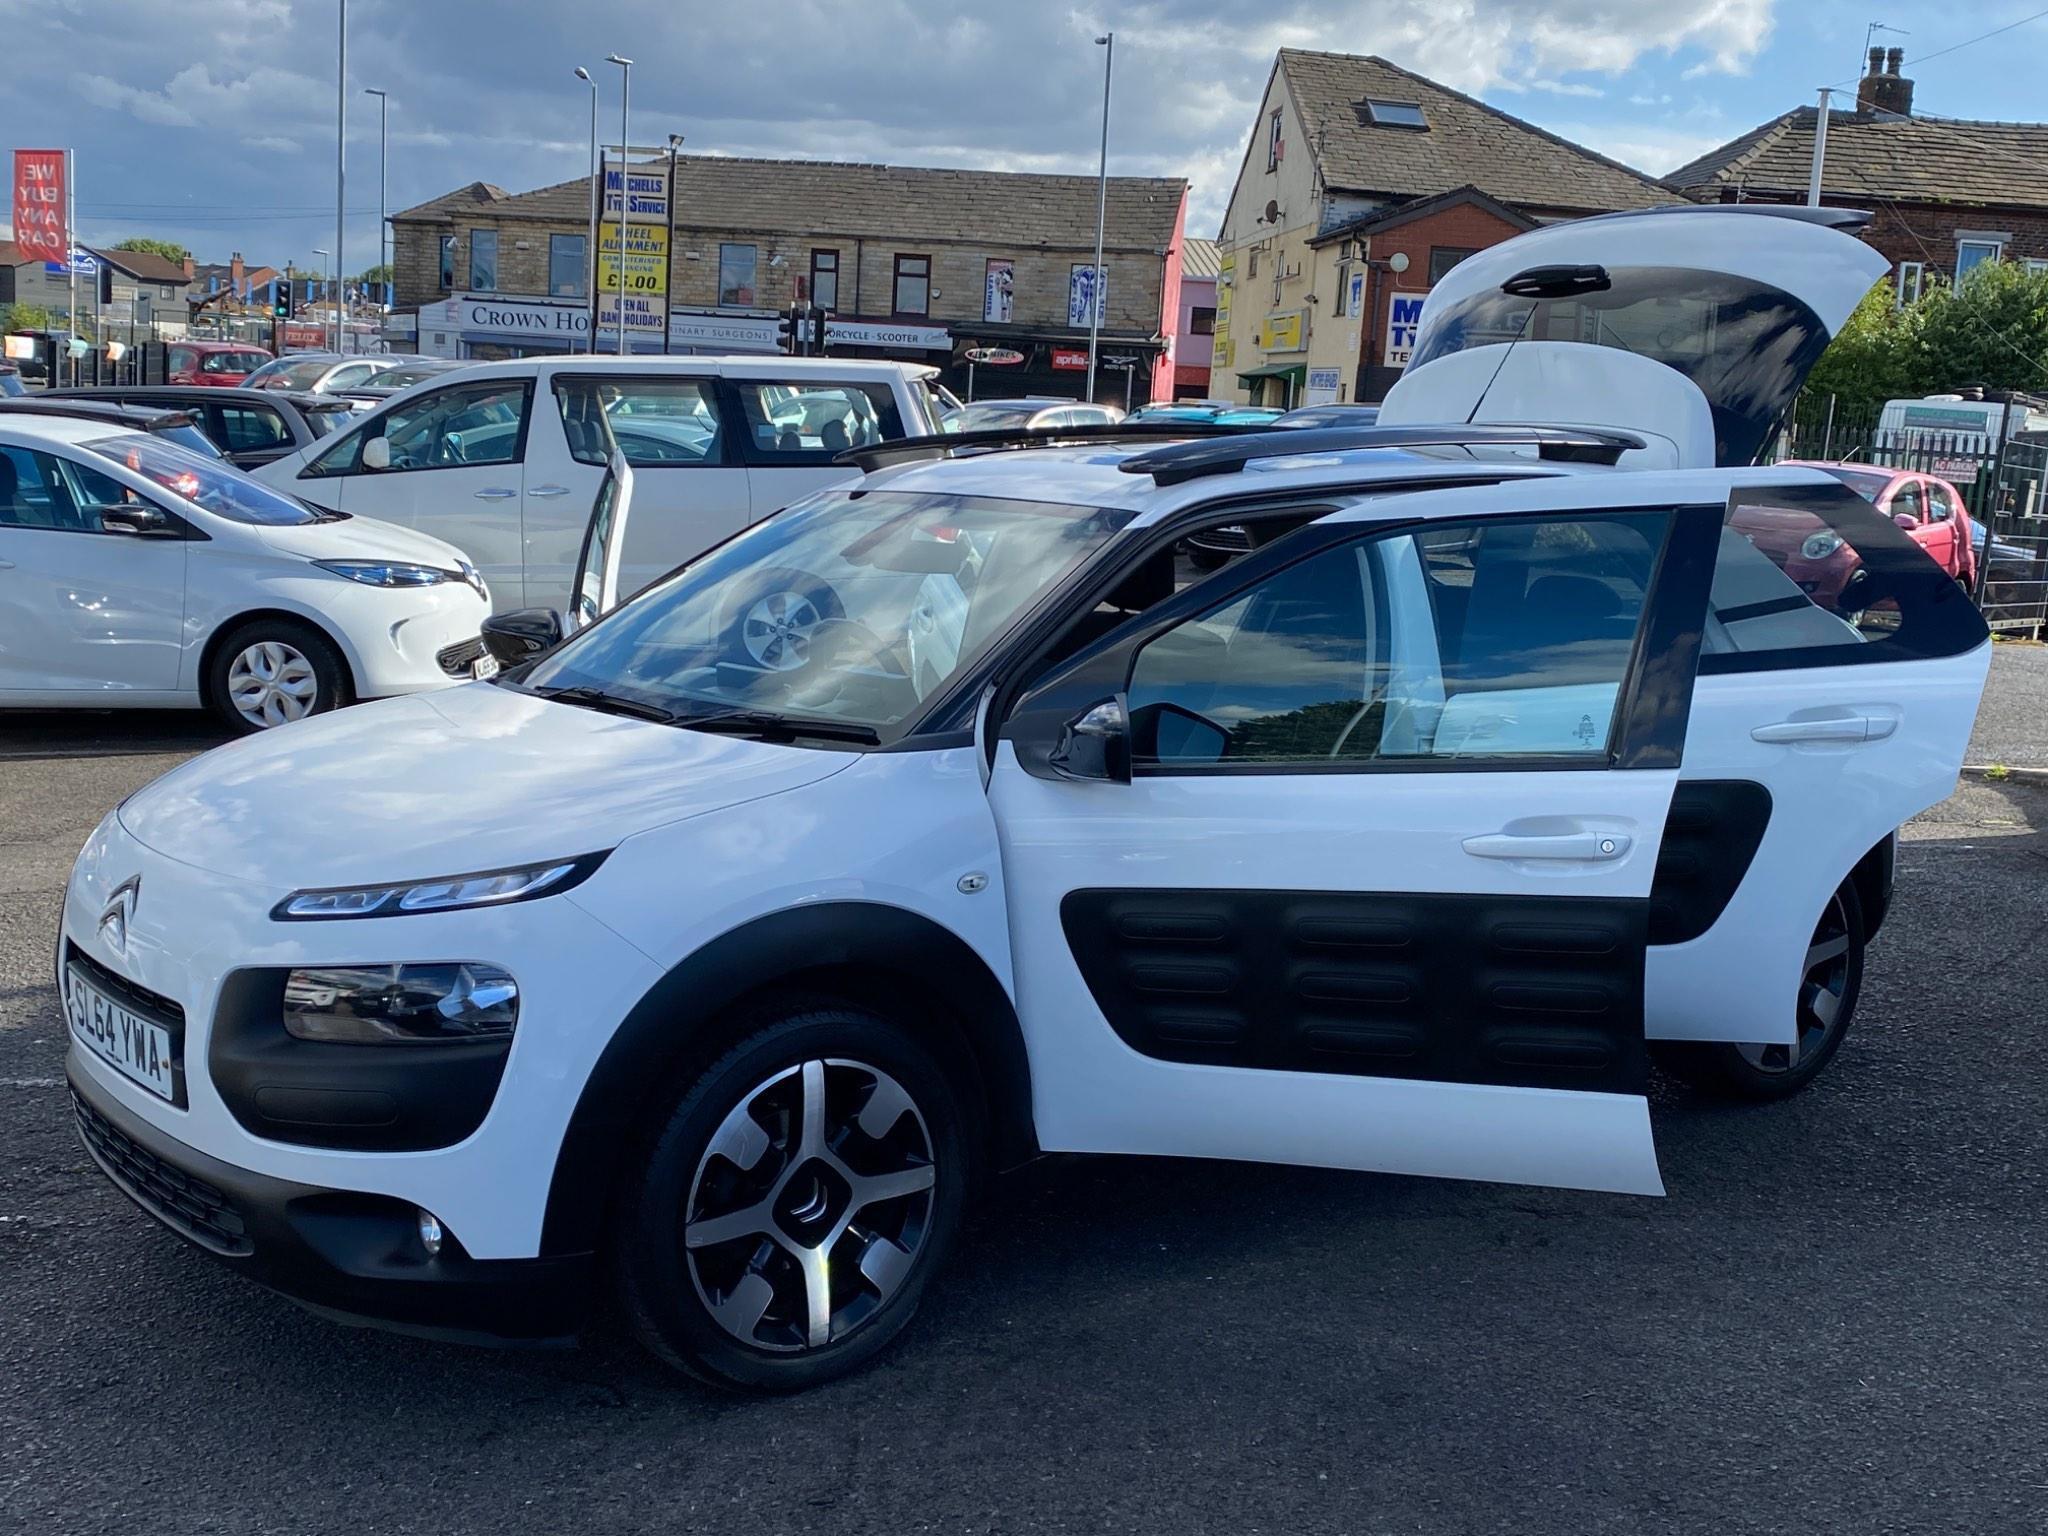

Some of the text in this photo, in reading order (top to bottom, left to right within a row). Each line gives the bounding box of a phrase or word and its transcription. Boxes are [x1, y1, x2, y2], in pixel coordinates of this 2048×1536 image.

[607, 171, 663, 192] MICHELLS
[629, 194, 666, 215] SERVICE
[636, 300, 650, 312] ALL
[472, 306, 547, 329] CROWN
[625, 314, 663, 328] HOLIDAYS
[712, 328, 768, 340] SURGEONS
[877, 332, 919, 343] SCOOTER
[1055, 354, 1085, 367] aprilia
[74, 979, 162, 1083] SL64 YWA
